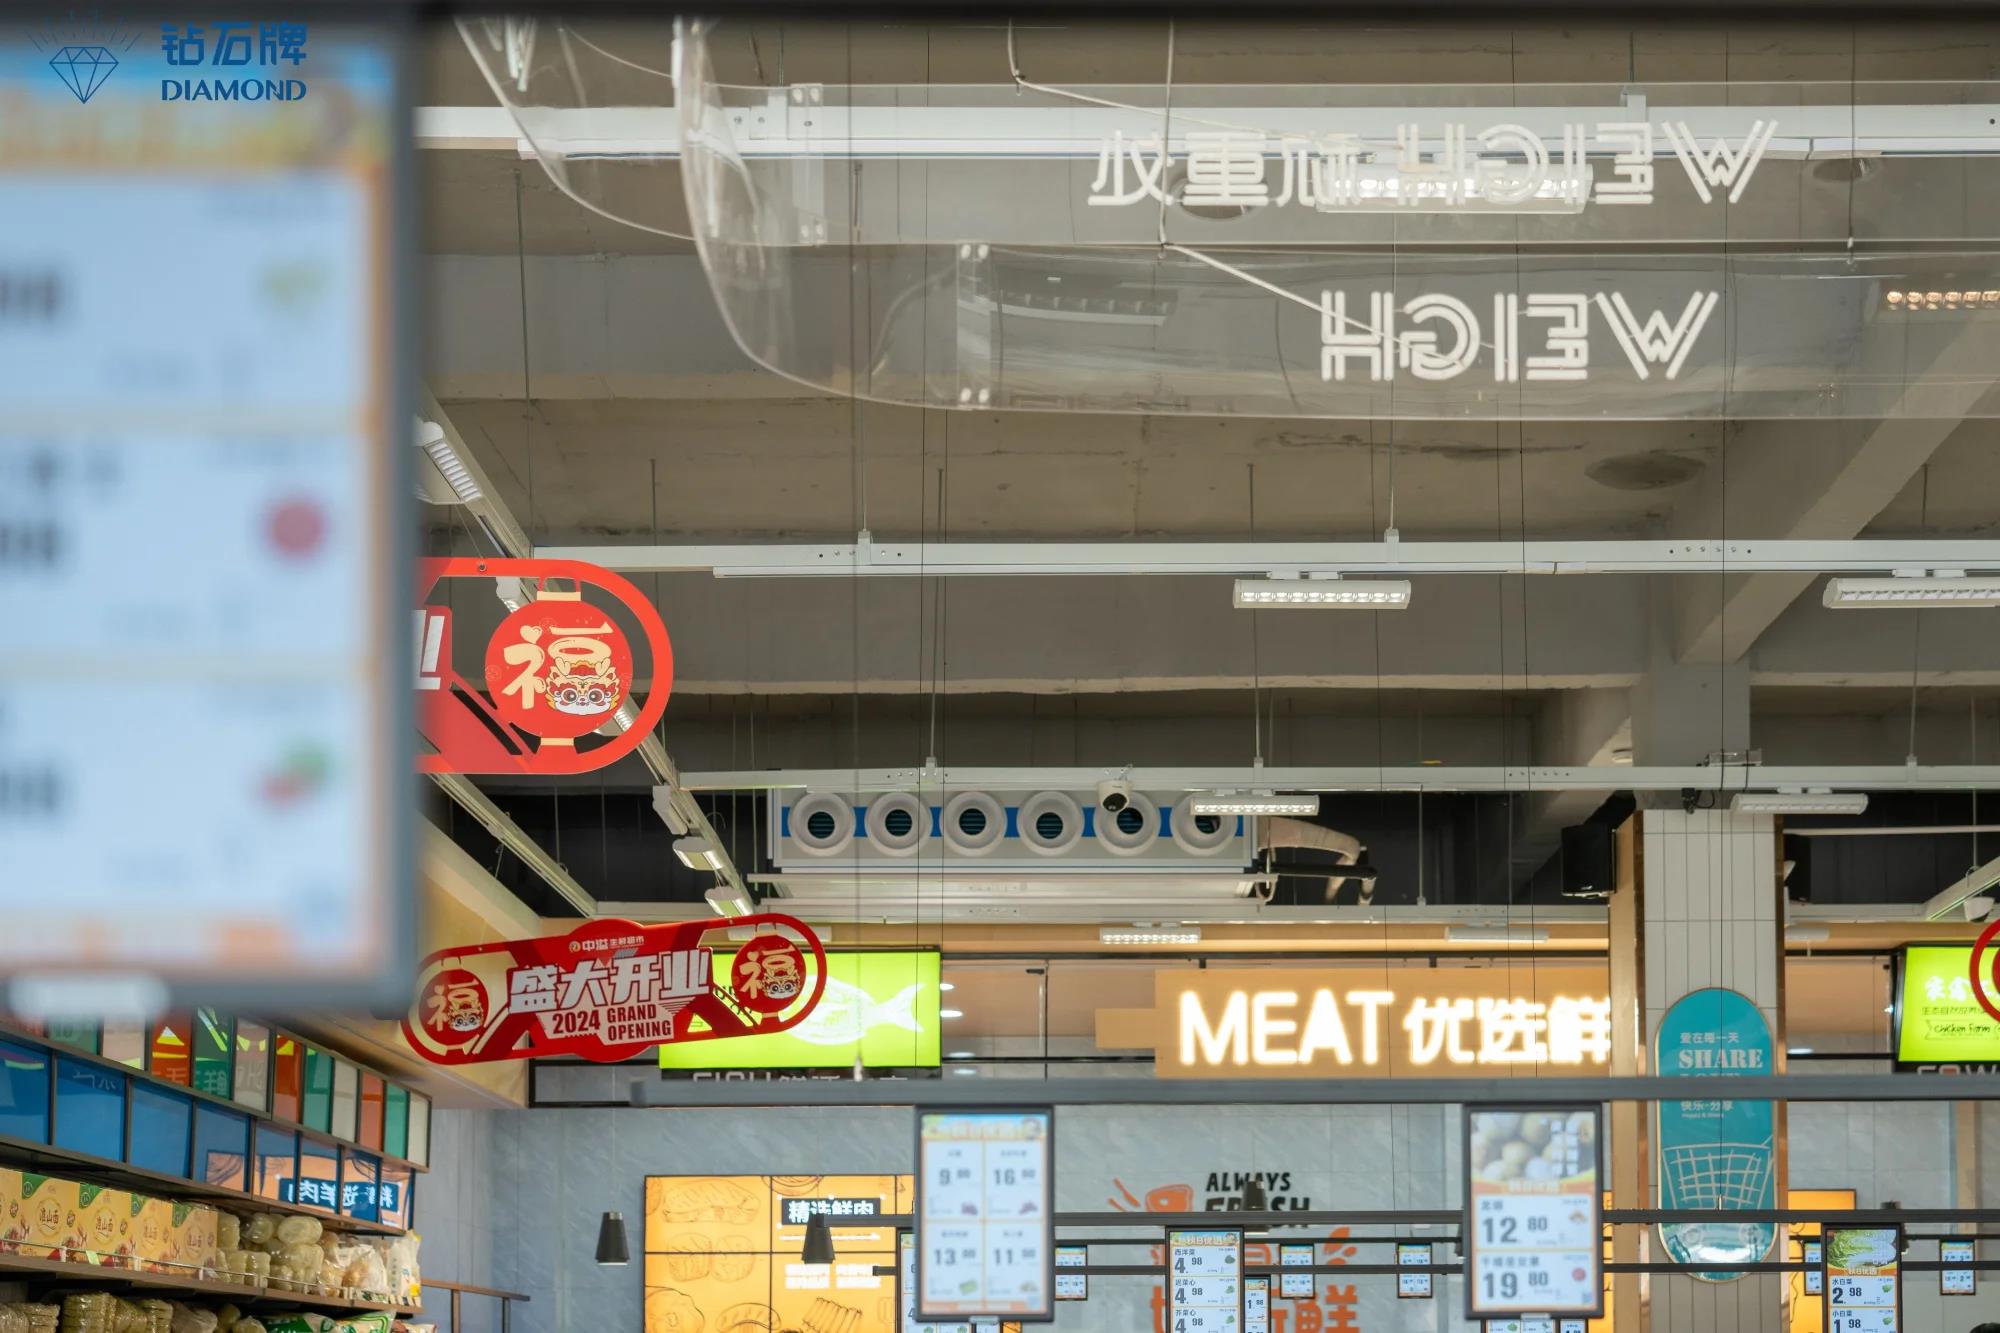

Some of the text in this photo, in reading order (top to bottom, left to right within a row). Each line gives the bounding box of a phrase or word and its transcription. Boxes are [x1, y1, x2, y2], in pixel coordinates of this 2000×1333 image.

[510, 951, 710, 1014] 盛大开业
[552, 1003, 657, 1035] 2024 GRAND
[608, 1019, 671, 1042] OPENING
[1178, 987, 1396, 1065] MEAT
[1679, 1049, 1763, 1069] SHARE
